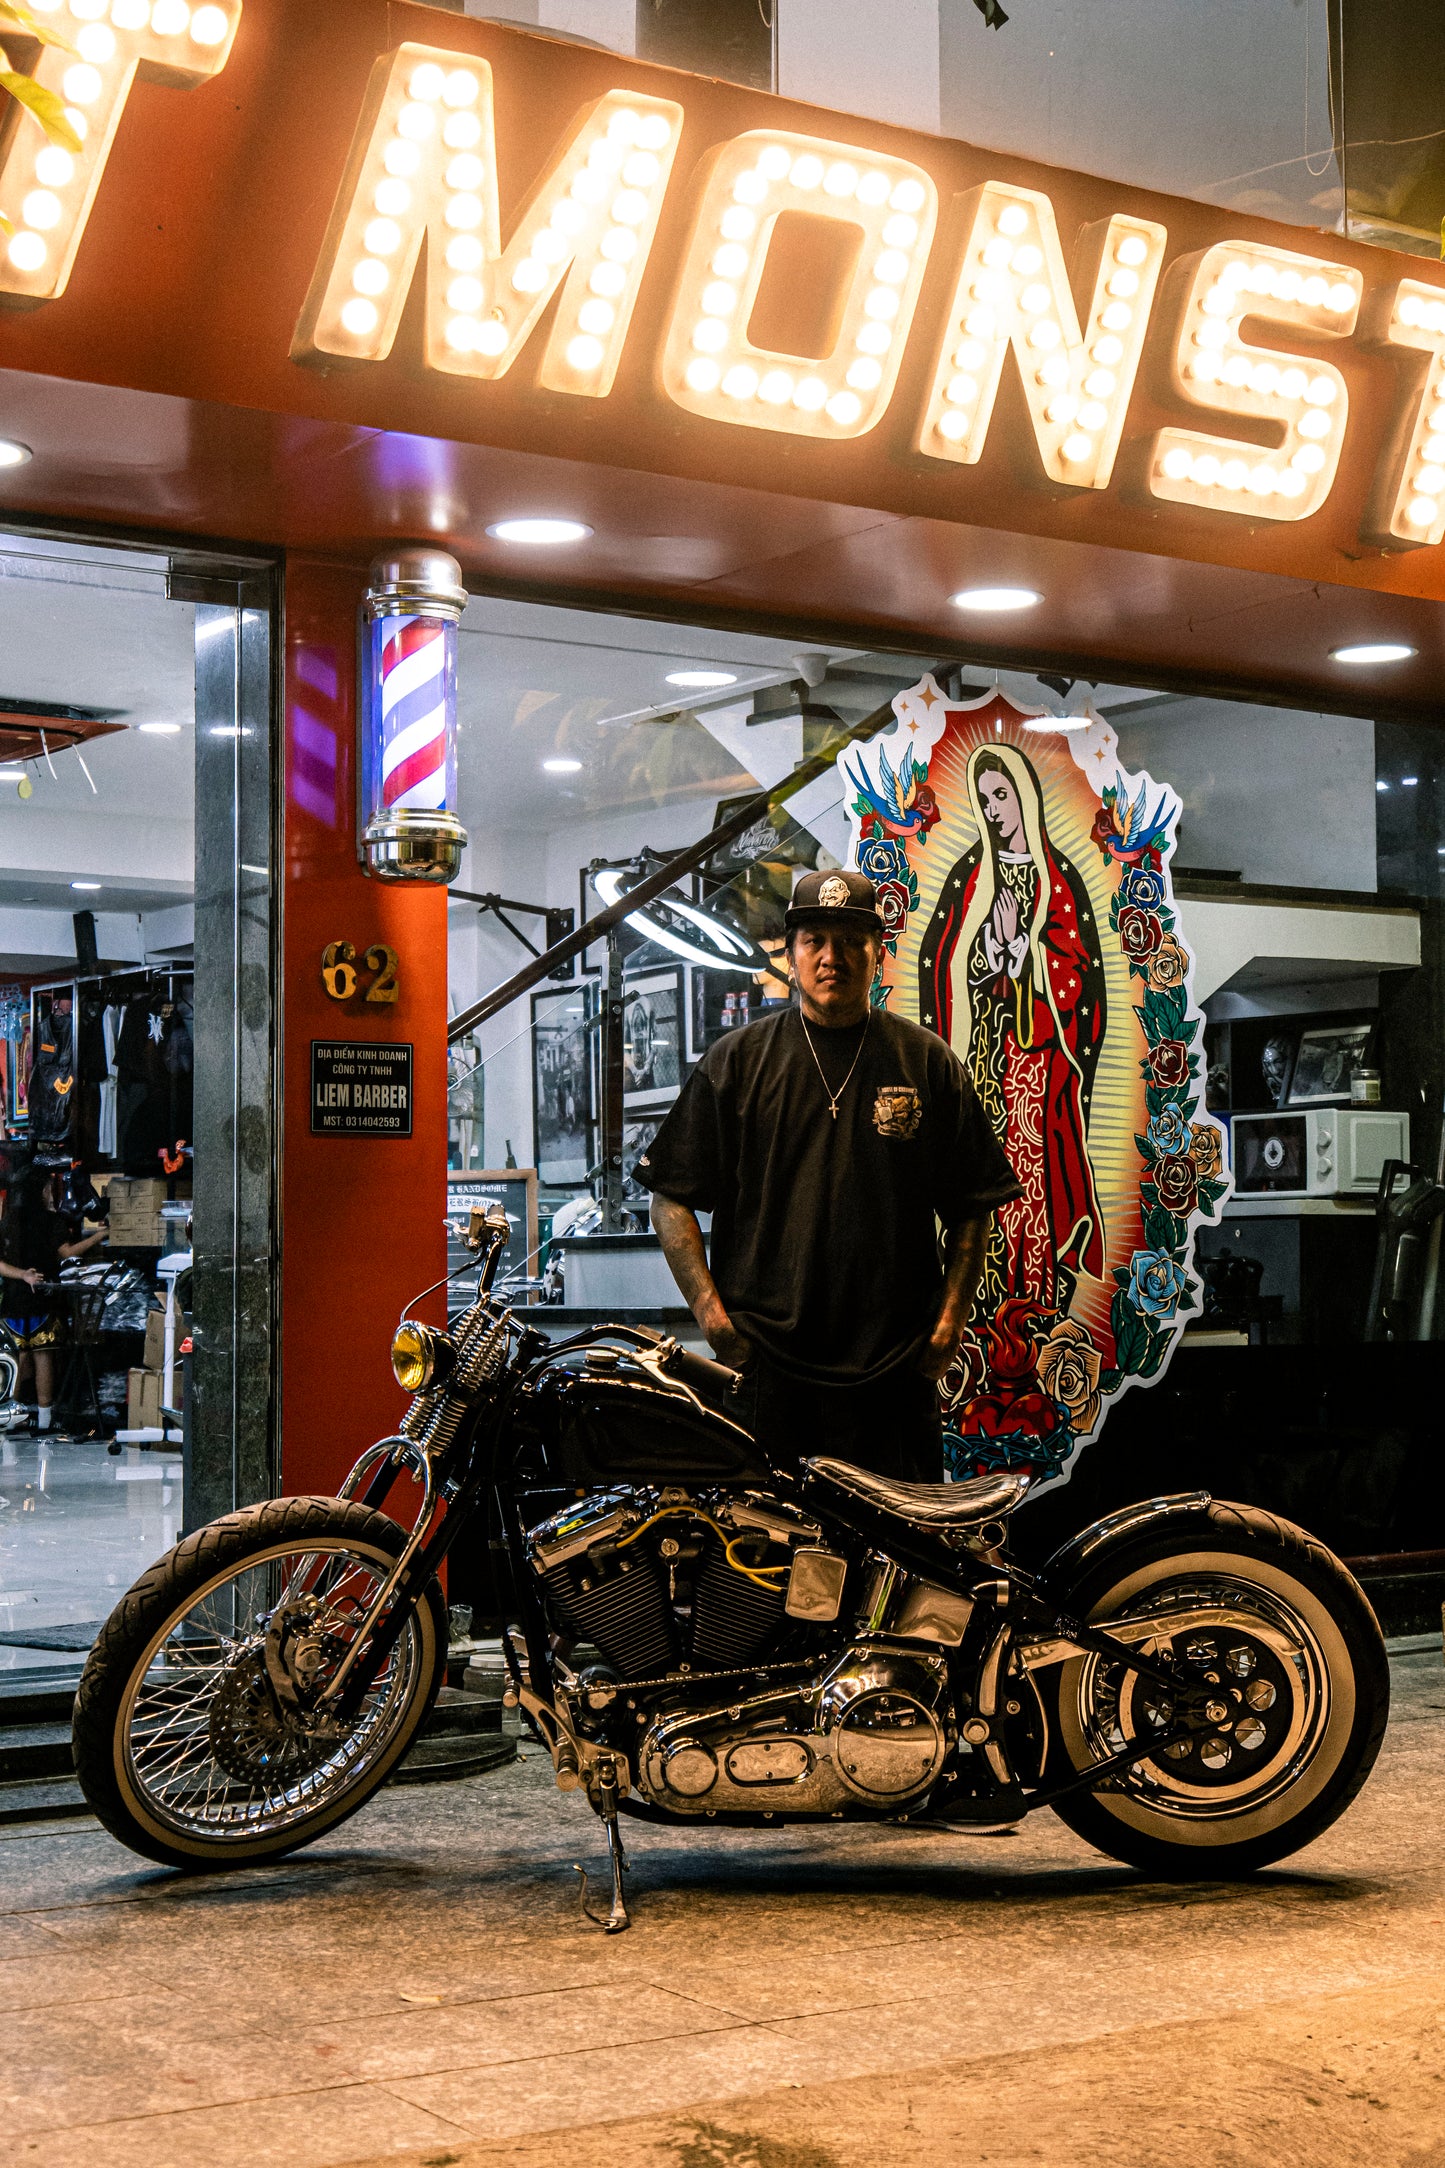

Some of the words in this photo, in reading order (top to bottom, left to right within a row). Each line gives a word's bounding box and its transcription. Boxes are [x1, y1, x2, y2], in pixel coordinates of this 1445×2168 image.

[322, 941, 398, 1002] 62
[357, 1050, 377, 1060] KINH
[379, 1051, 407, 1061] DOANH
[332, 1062, 355, 1074] CÔNG
[357, 1065, 367, 1075] TY
[370, 1066, 392, 1076] TNHH
[316, 1083, 350, 1107] LIEM
[354, 1084, 407, 1109] BARBER
[323, 1115, 344, 1127] MST:
[345, 1116, 400, 1127] 0314042593
